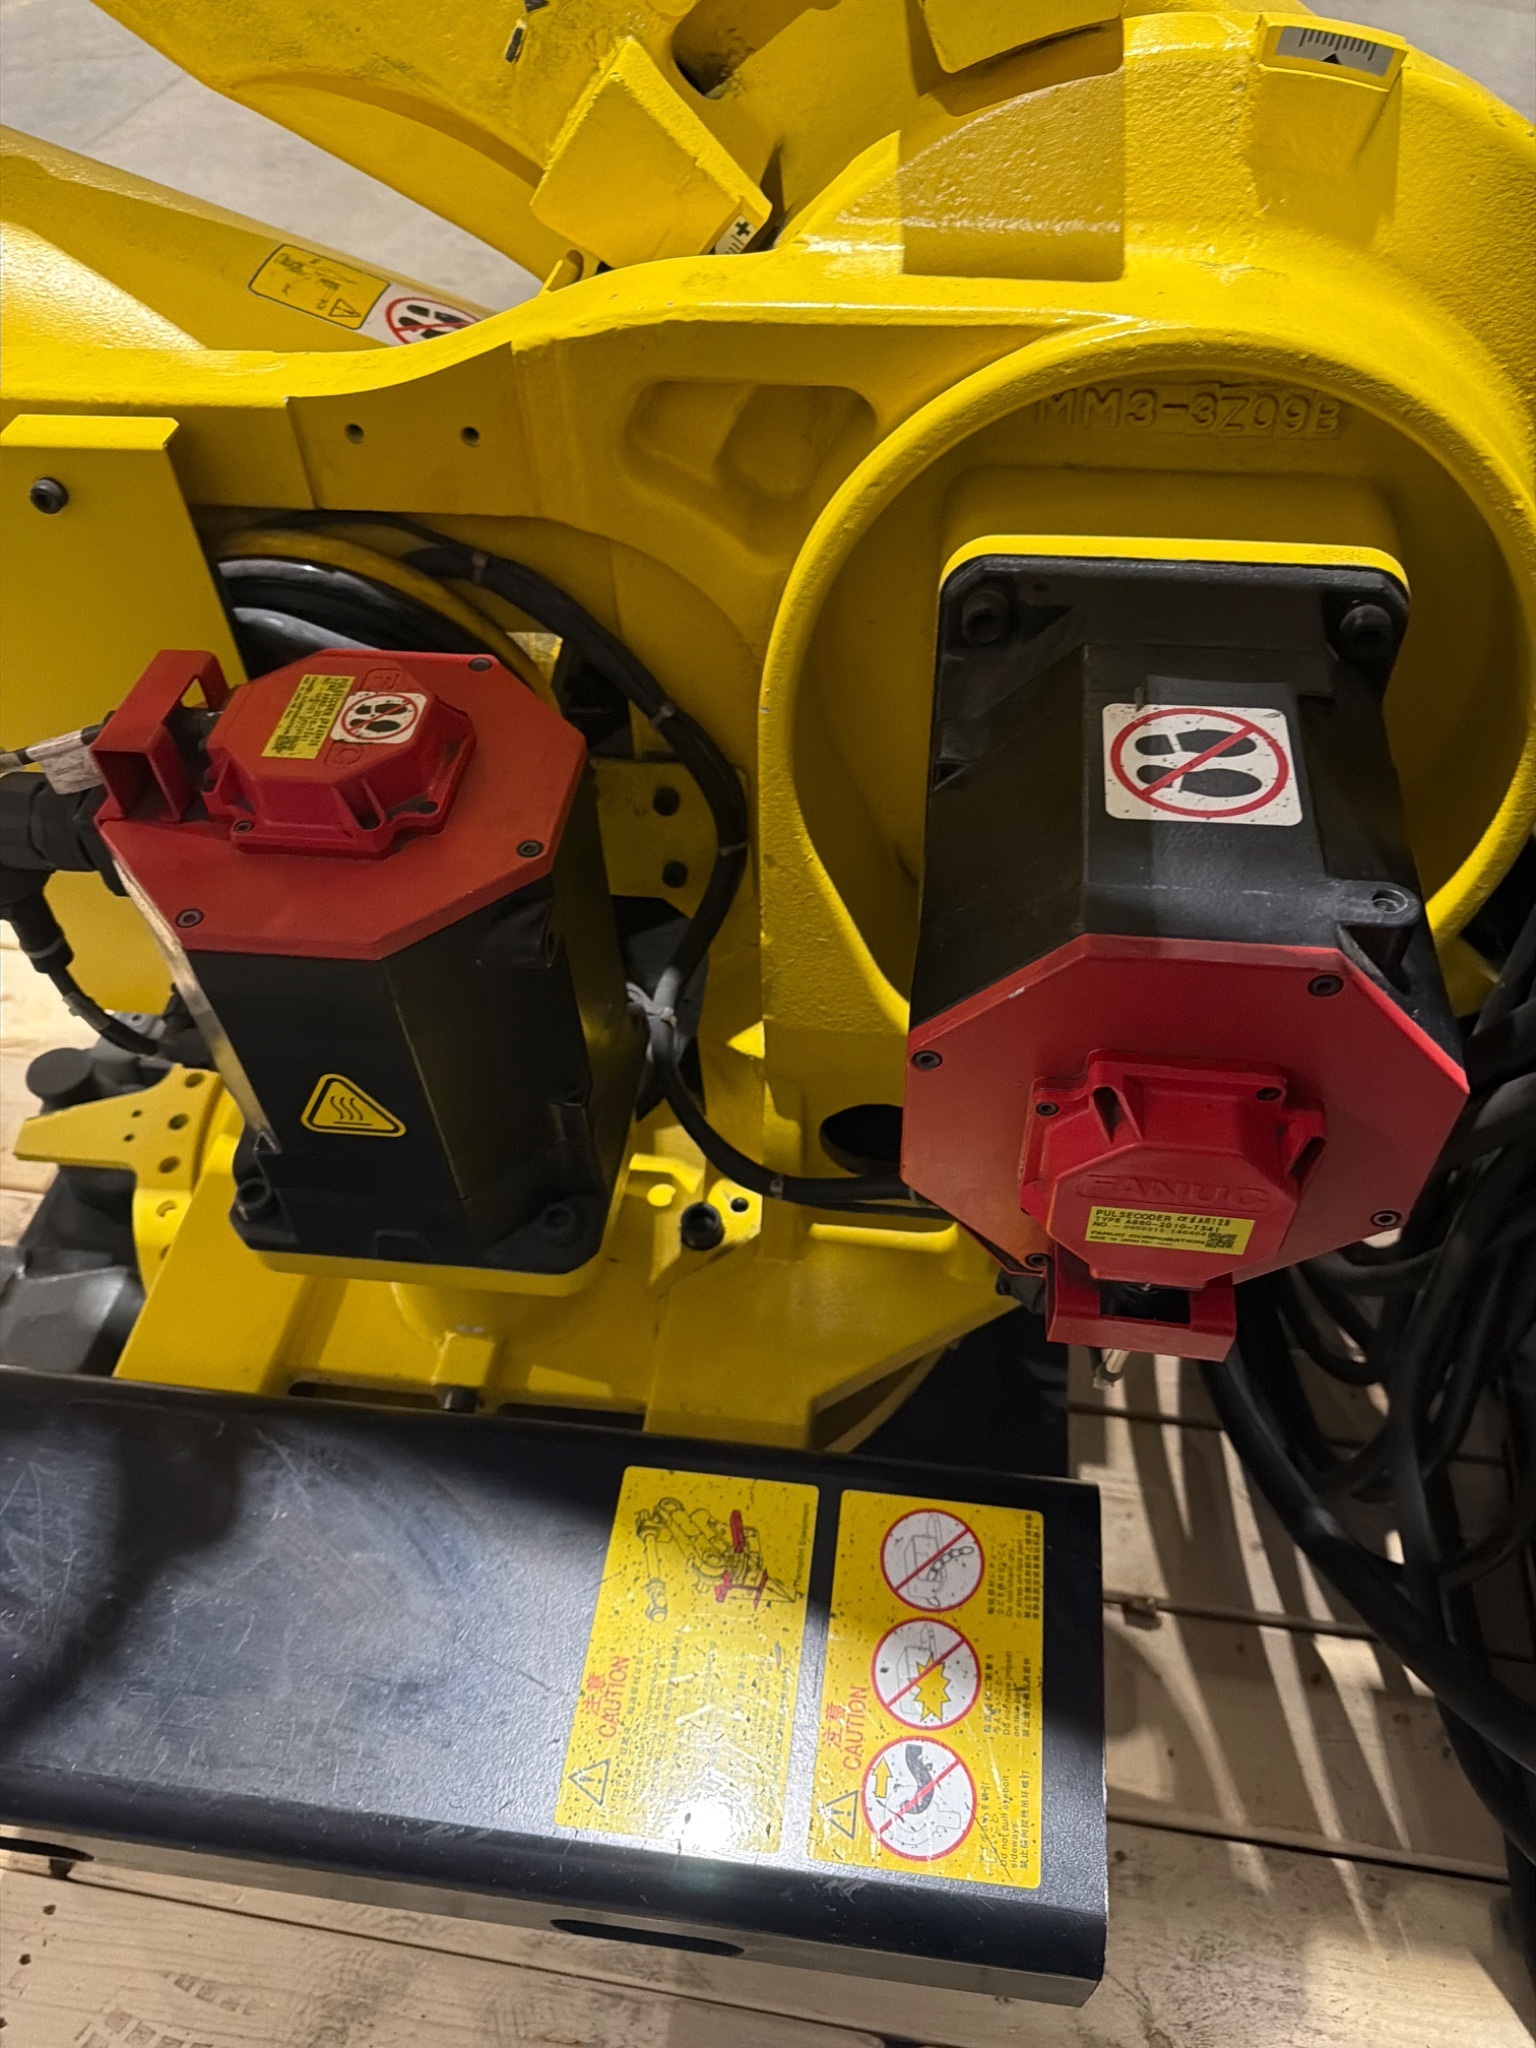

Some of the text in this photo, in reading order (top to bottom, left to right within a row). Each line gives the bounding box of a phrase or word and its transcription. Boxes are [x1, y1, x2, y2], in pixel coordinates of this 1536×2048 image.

[1086, 1174, 1271, 1207] FANUC
[1095, 1209, 1172, 1221] PULSECODER
[580, 1672, 606, 1715] 注意
[597, 1654, 630, 1738] CAUTION
[821, 1701, 845, 1748] 注意
[842, 1684, 867, 1771] CAUTION
[1002, 1722, 1010, 1735] Do
[1013, 1725, 1019, 1736] on
[998, 1774, 1011, 1866] Do not pull eyebolt
